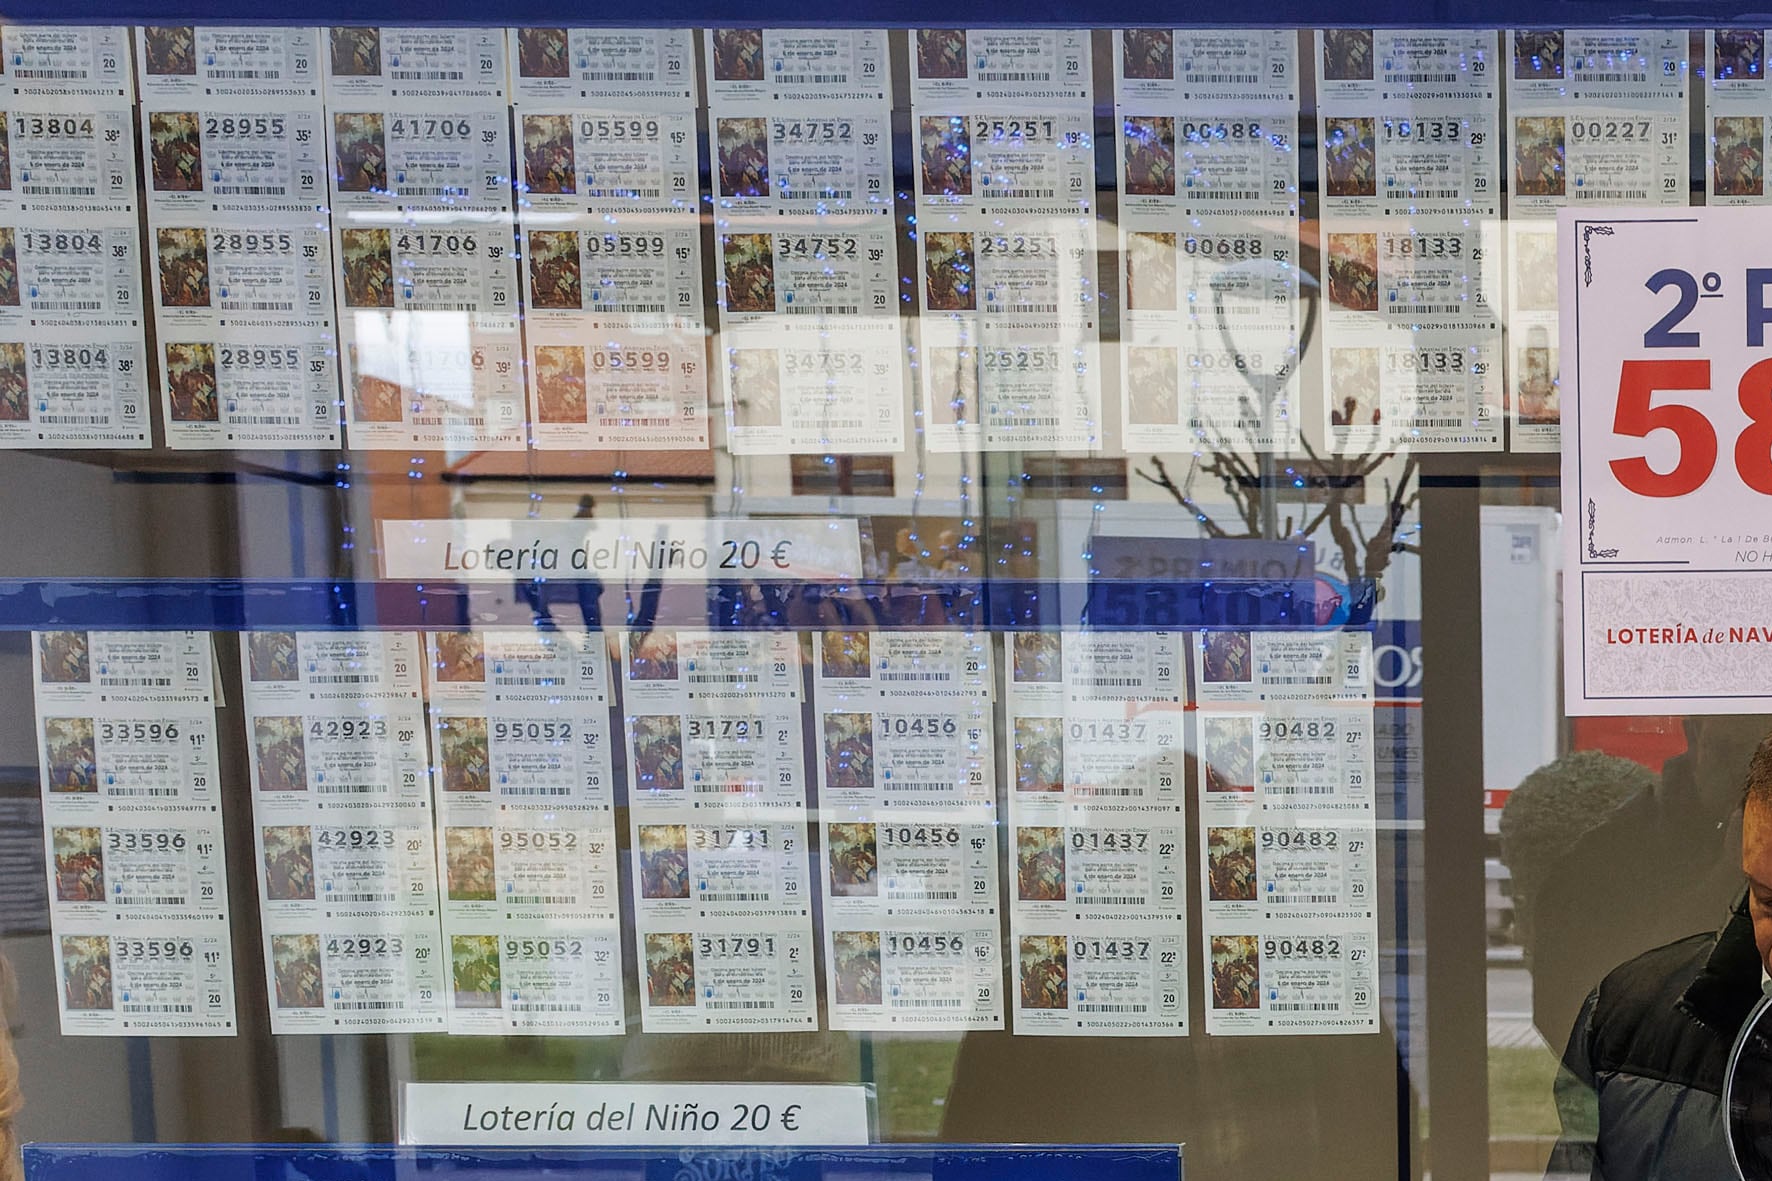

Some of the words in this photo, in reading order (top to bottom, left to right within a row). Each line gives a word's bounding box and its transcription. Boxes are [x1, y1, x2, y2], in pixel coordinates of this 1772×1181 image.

[15, 119, 94, 138] 13804
[206, 118, 286, 137] 28955
[391, 118, 472, 137] 41706
[580, 119, 659, 139] 05599
[772, 121, 852, 141] 34752
[976, 121, 1054, 139] 25251
[1572, 122, 1652, 140] 00227
[24, 233, 101, 252] 13804
[214, 234, 292, 252] 28955
[398, 234, 477, 252] 41706
[586, 236, 665, 254] 05599
[779, 236, 858, 256] 34752
[1184, 238, 1262, 256] 00688
[1384, 237, 1462, 256] 18133
[1643, 269, 1724, 348] 2º
[443, 539, 563, 572] Lotería
[570, 538, 627, 570] del
[632, 538, 709, 571] Niño
[719, 540, 761, 570] 20
[769, 541, 793, 570] €
[1735, 550, 1758, 562] NO
[1606, 622, 1697, 645] LOTERÍA
[1702, 628, 1724, 644] de
[100, 722, 180, 742] 33596
[310, 721, 388, 740] 42923
[494, 721, 573, 740] 95052
[880, 717, 957, 737] 10456
[115, 941, 194, 960] 33596
[1074, 939, 1151, 959] 01437
[1264, 937, 1341, 956] 90482
[1163, 992, 1176, 1004] 20
[1354, 991, 1367, 1002] 20
[463, 1101, 575, 1133] Lotería
[585, 1102, 635, 1131] del
[645, 1102, 720, 1131] Niño
[730, 1103, 772, 1131] 20
[780, 1104, 802, 1131] €
